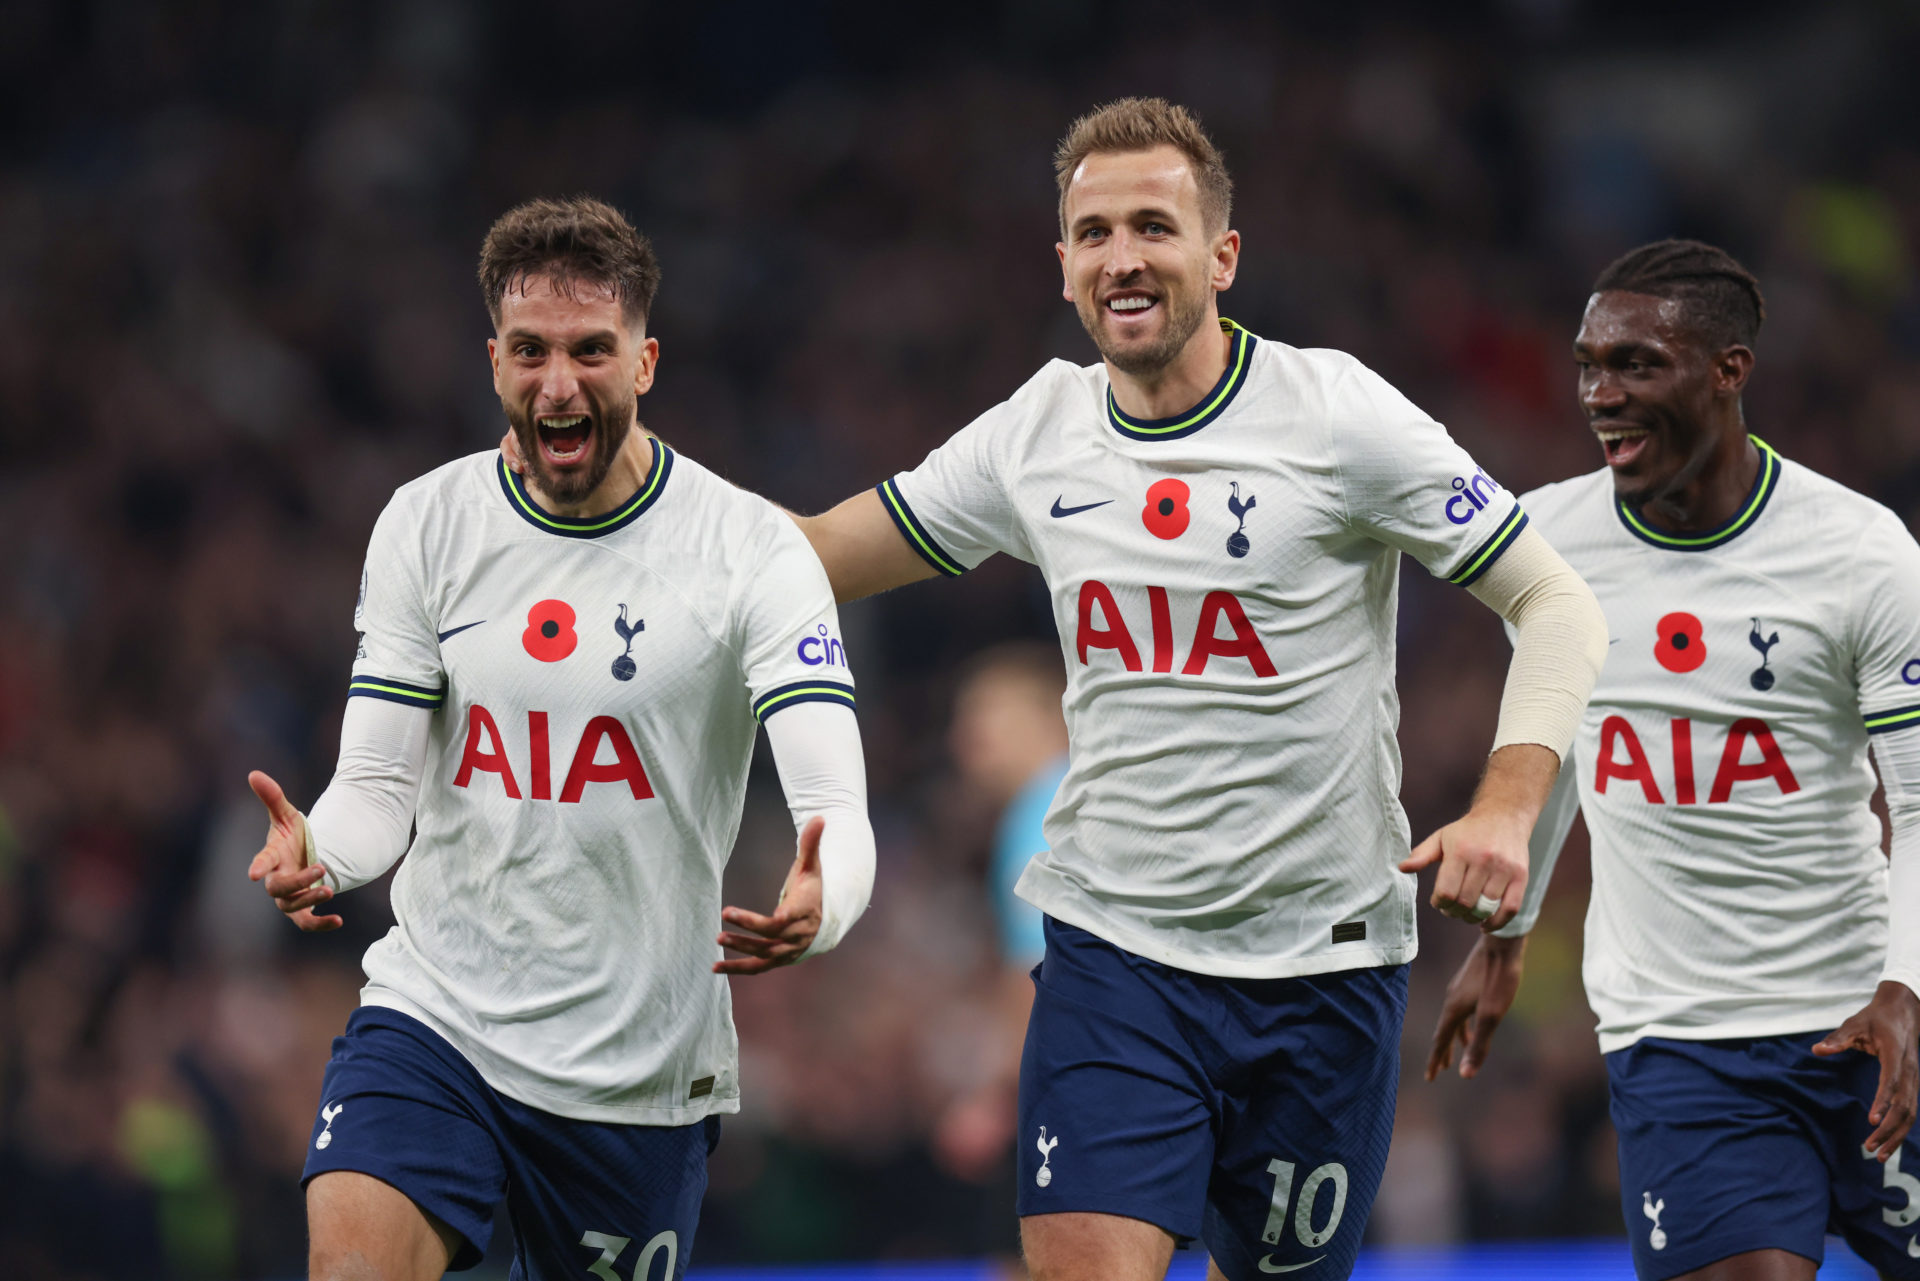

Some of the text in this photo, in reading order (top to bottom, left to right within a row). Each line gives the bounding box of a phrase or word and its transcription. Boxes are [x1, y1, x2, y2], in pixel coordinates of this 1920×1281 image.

[797, 623, 847, 668] cin
[1076, 579, 1278, 678] AIA
[453, 704, 655, 804] AIA
[1594, 715, 1801, 805] AIA
[1261, 1157, 1349, 1248] 10
[578, 1229, 678, 1281] 30
